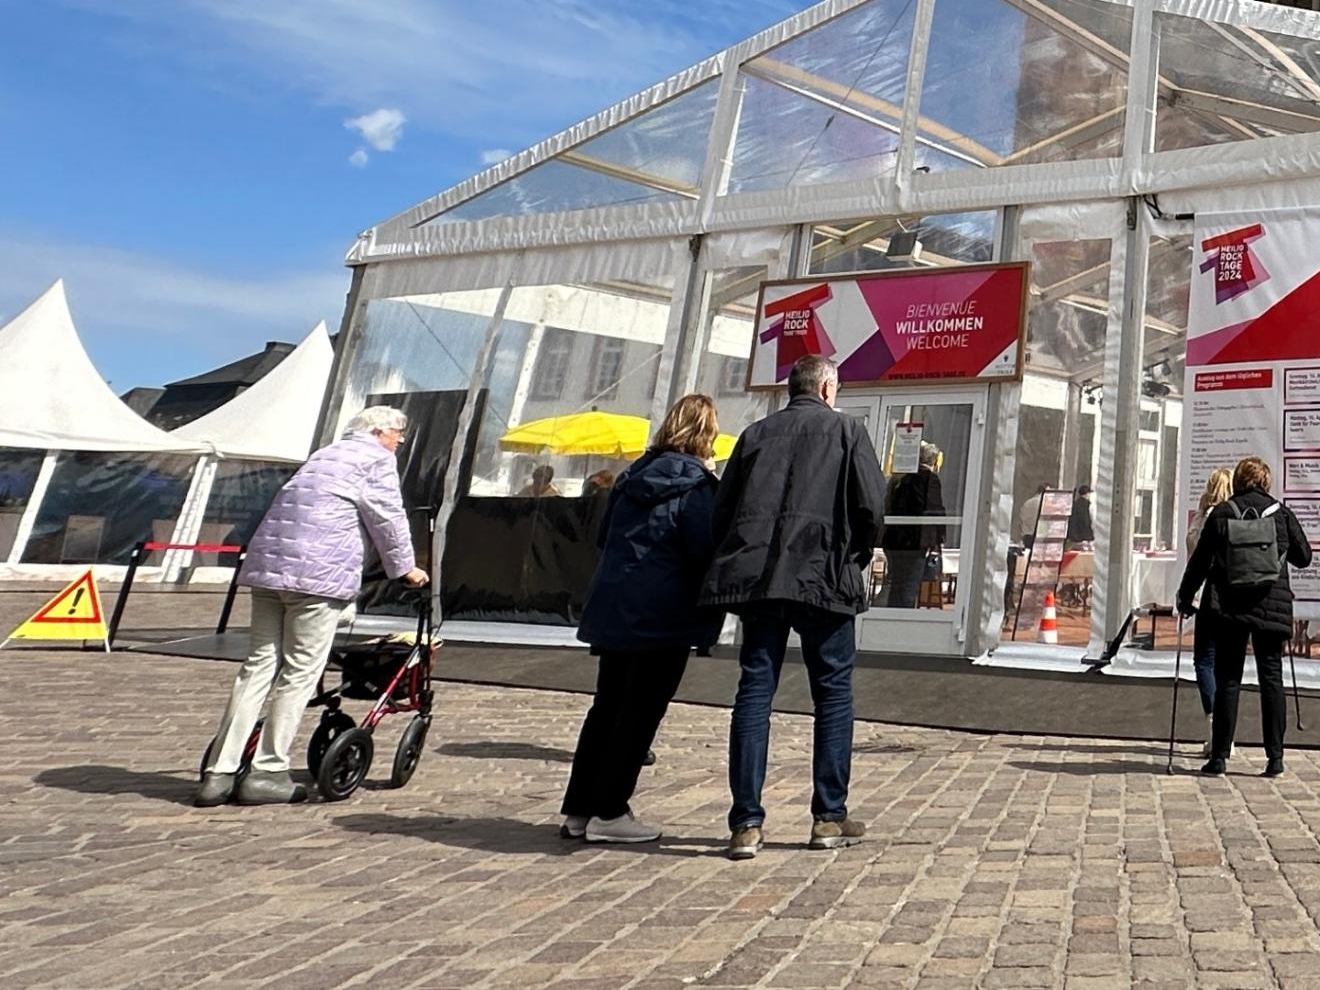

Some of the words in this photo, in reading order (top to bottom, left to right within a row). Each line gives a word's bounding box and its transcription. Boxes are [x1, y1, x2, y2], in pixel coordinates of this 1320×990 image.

[1220, 244, 1245, 253] HEILIG
[1220, 252, 1243, 261] ROCK
[1220, 260, 1243, 271] TAGE
[1218, 270, 1242, 281] 2024
[785, 309, 810, 320] HEILIG
[906, 300, 977, 319] BIENVENUE
[784, 319, 809, 330] ROCK
[896, 316, 984, 335] WILLKOMMEN
[906, 333, 970, 350] WELCOME
